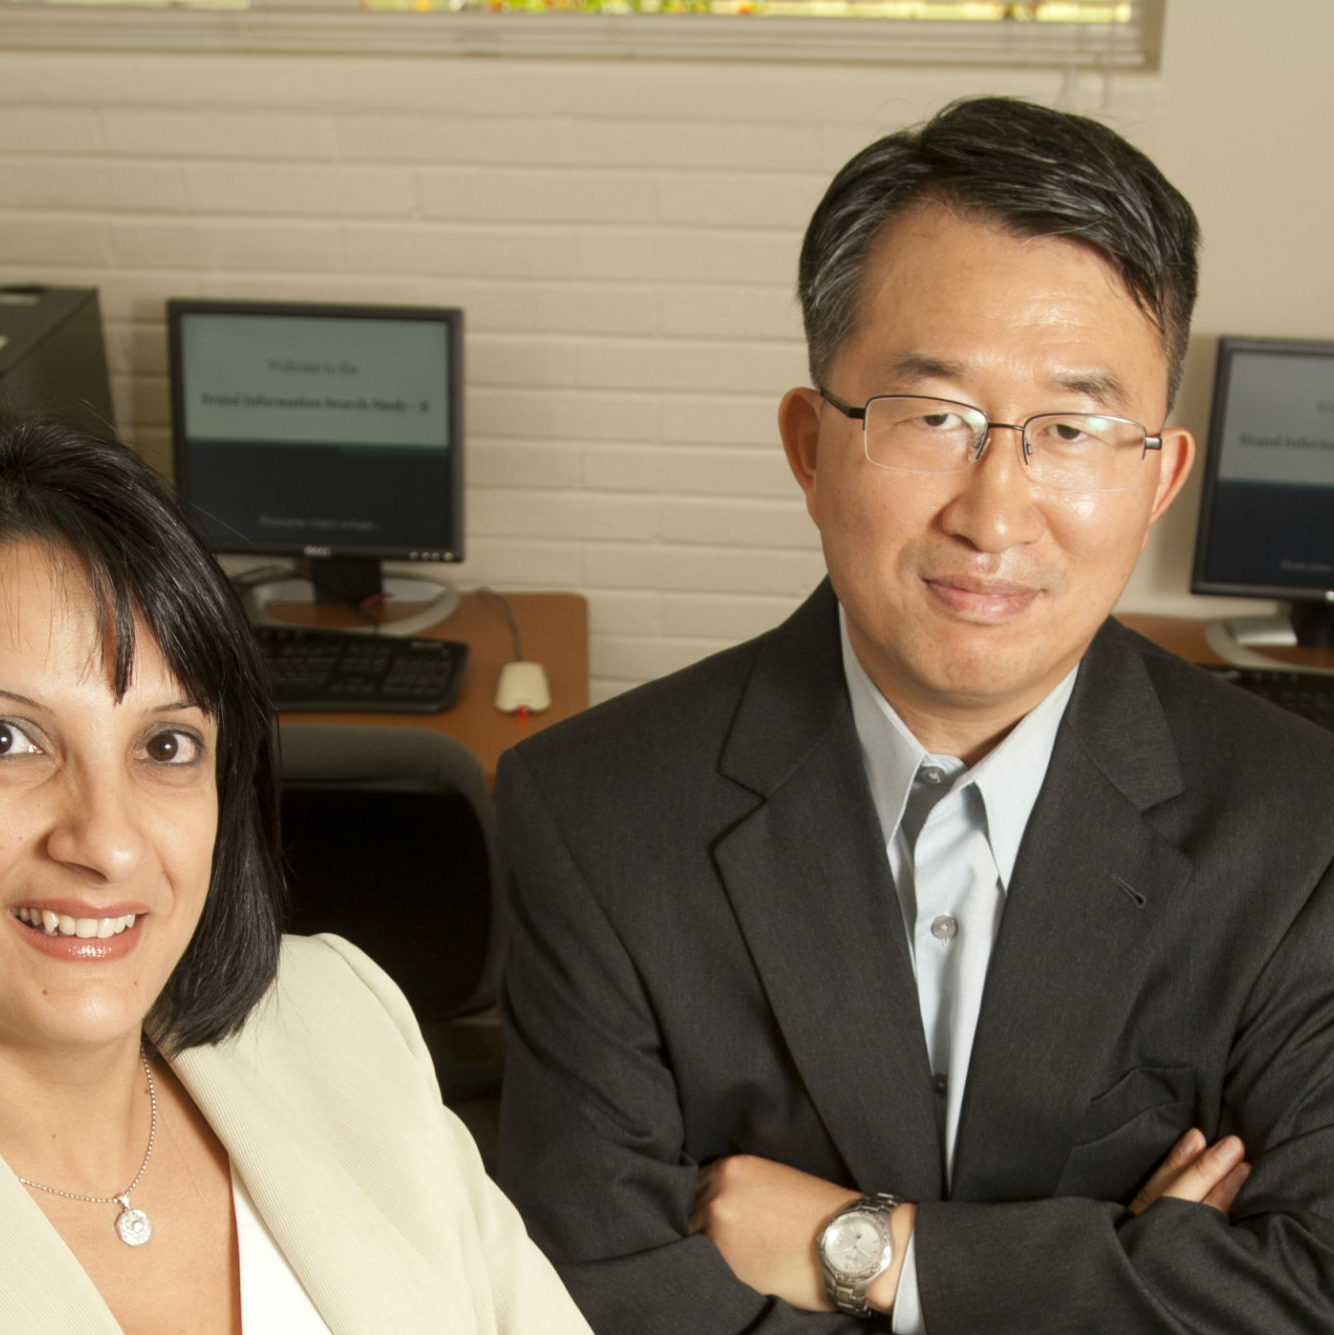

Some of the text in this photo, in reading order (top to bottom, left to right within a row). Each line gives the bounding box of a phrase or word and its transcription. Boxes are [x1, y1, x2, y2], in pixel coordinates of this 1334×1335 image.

[268, 358, 320, 374] Welcome
[201, 392, 239, 407] Brand
[243, 394, 321, 409] Information
[325, 397, 367, 411] Search
[372, 398, 406, 413] Study
[1240, 432, 1282, 448] Brand
